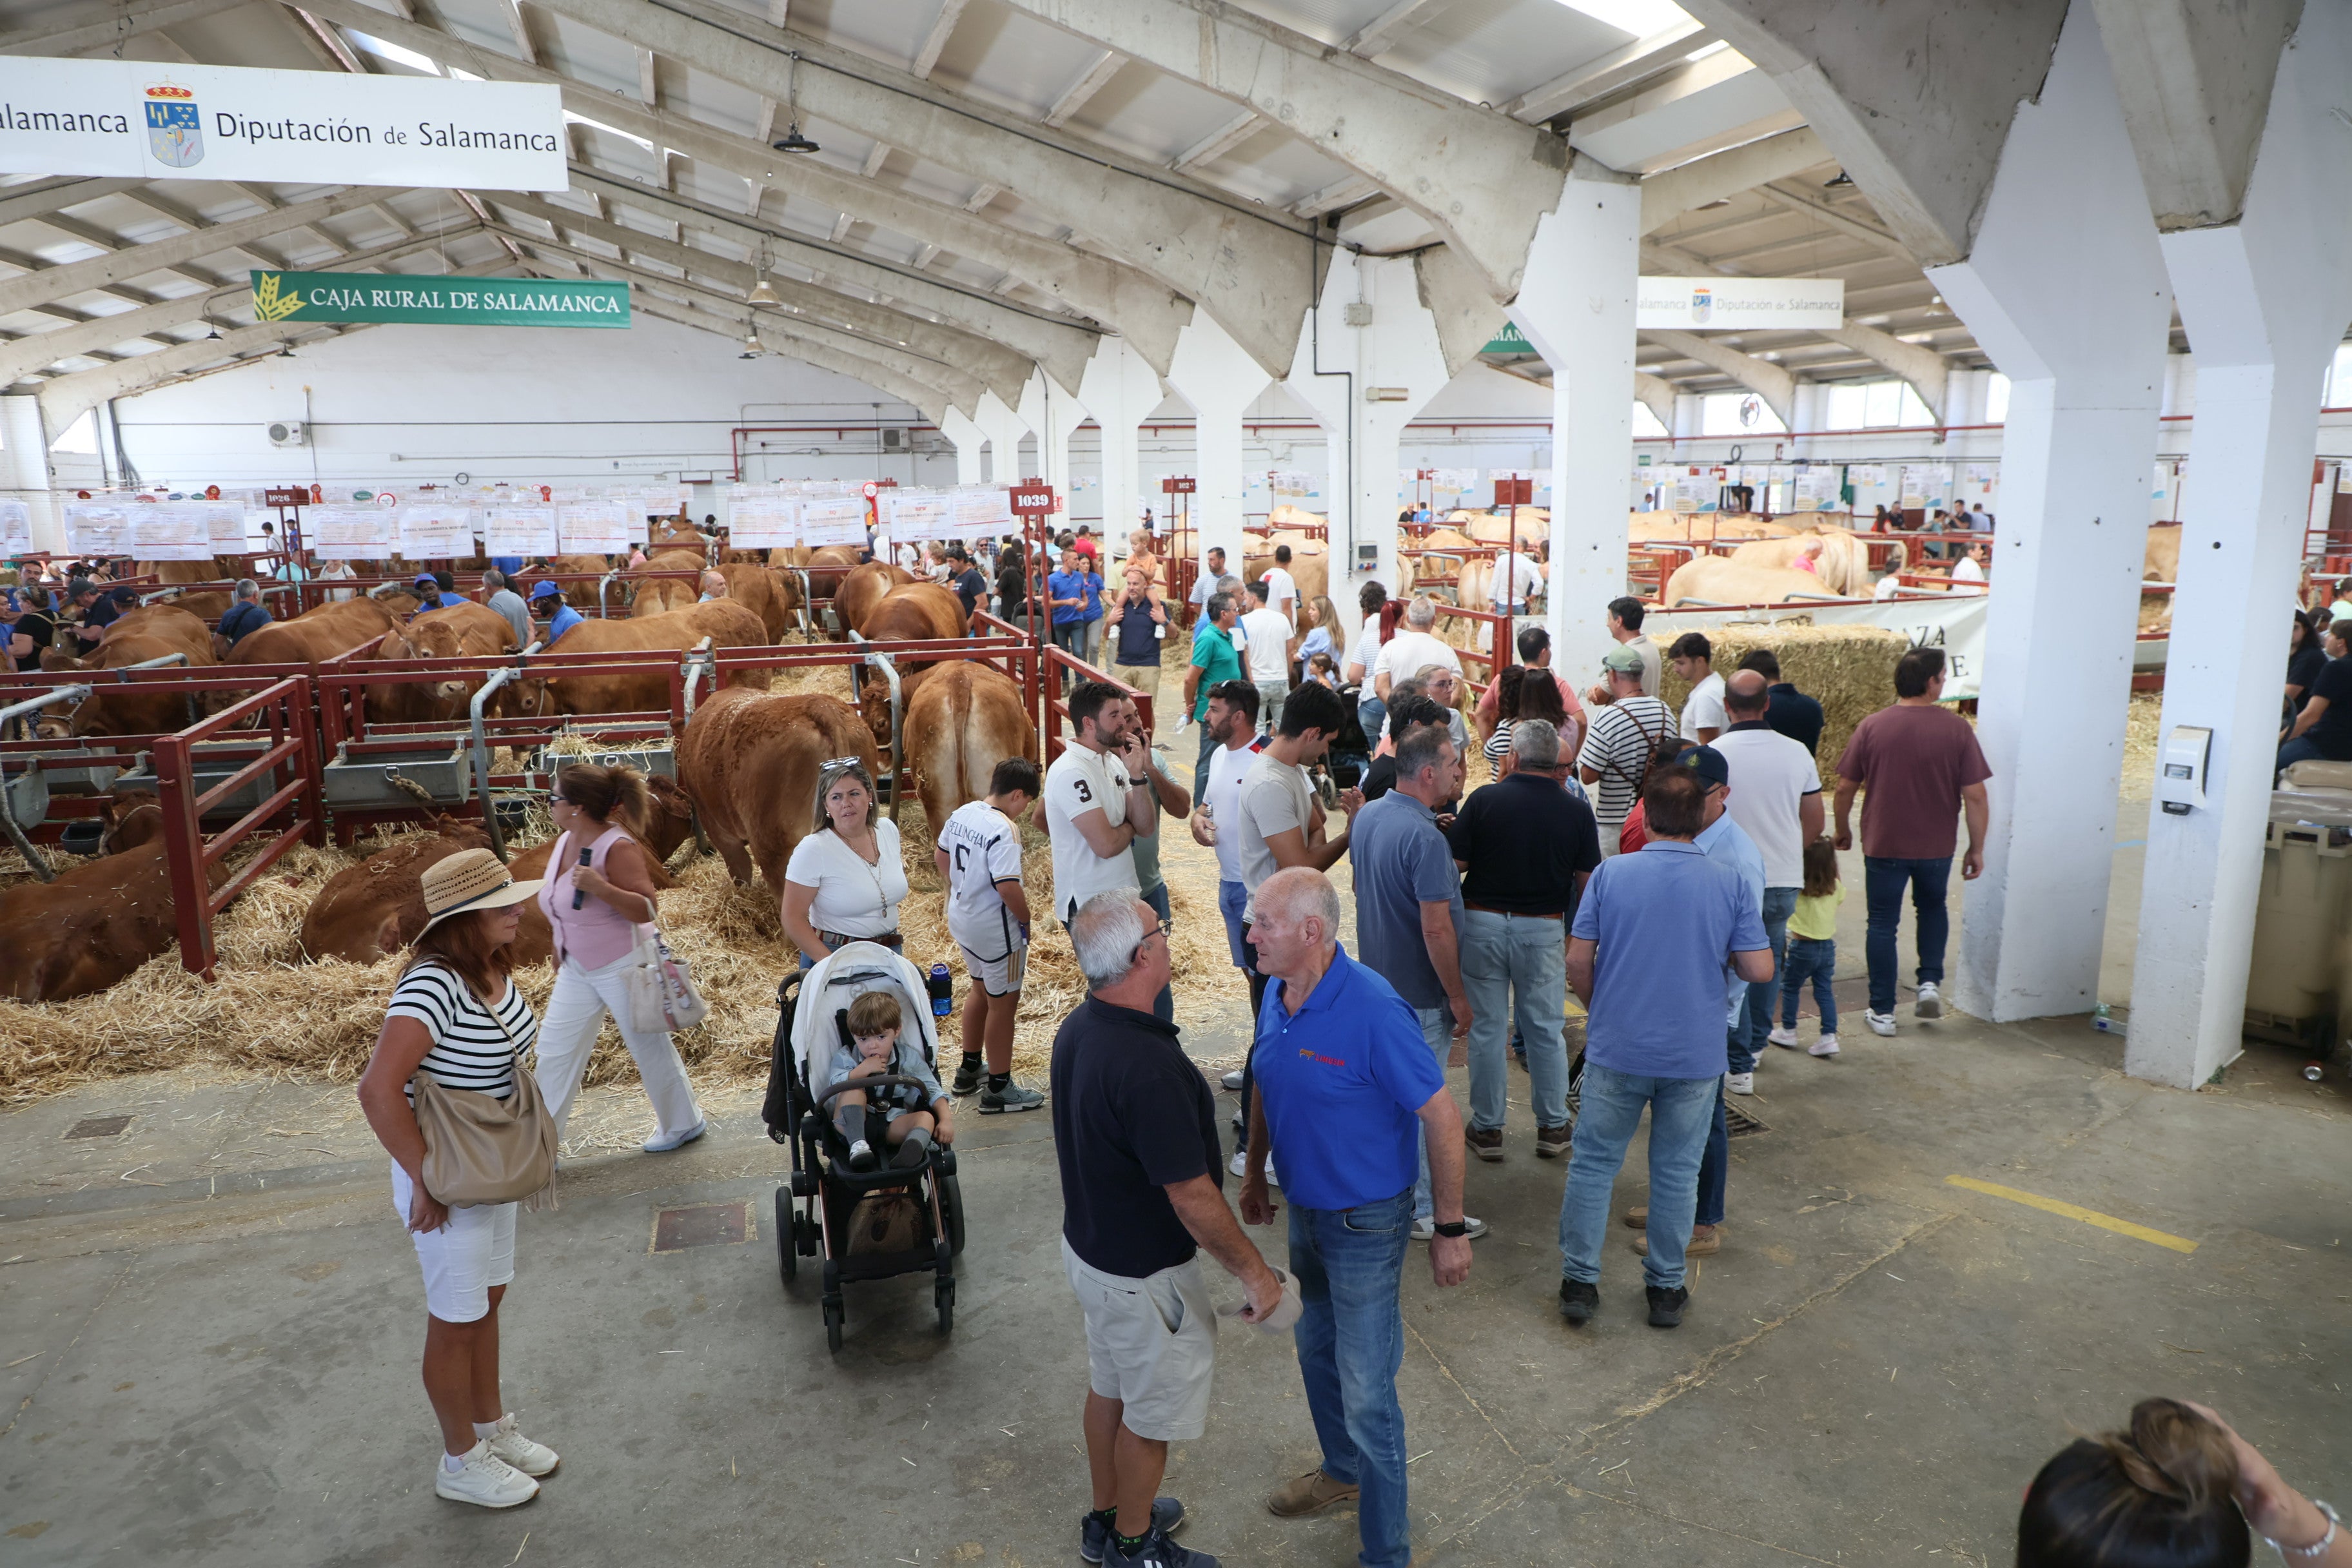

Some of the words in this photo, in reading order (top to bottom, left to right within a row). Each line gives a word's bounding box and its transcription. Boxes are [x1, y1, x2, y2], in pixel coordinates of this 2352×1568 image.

[216, 113, 371, 145] Diputación
[384, 126, 407, 145] de
[420, 122, 558, 152] Salamanca
[310, 288, 366, 311] CAJA
[371, 290, 445, 309] RURAL
[450, 291, 478, 310] DE
[483, 293, 621, 313] SALAMANCA
[1639, 297, 1687, 310] alamanca
[1716, 298, 1772, 312] Diputación
[1776, 301, 1785, 310] de
[1789, 298, 1841, 310] Salamanca
[1017, 494, 1049, 507] 1039
[1073, 779, 1092, 803] 3
[1315, 1053, 1346, 1067] LIMUSIN
